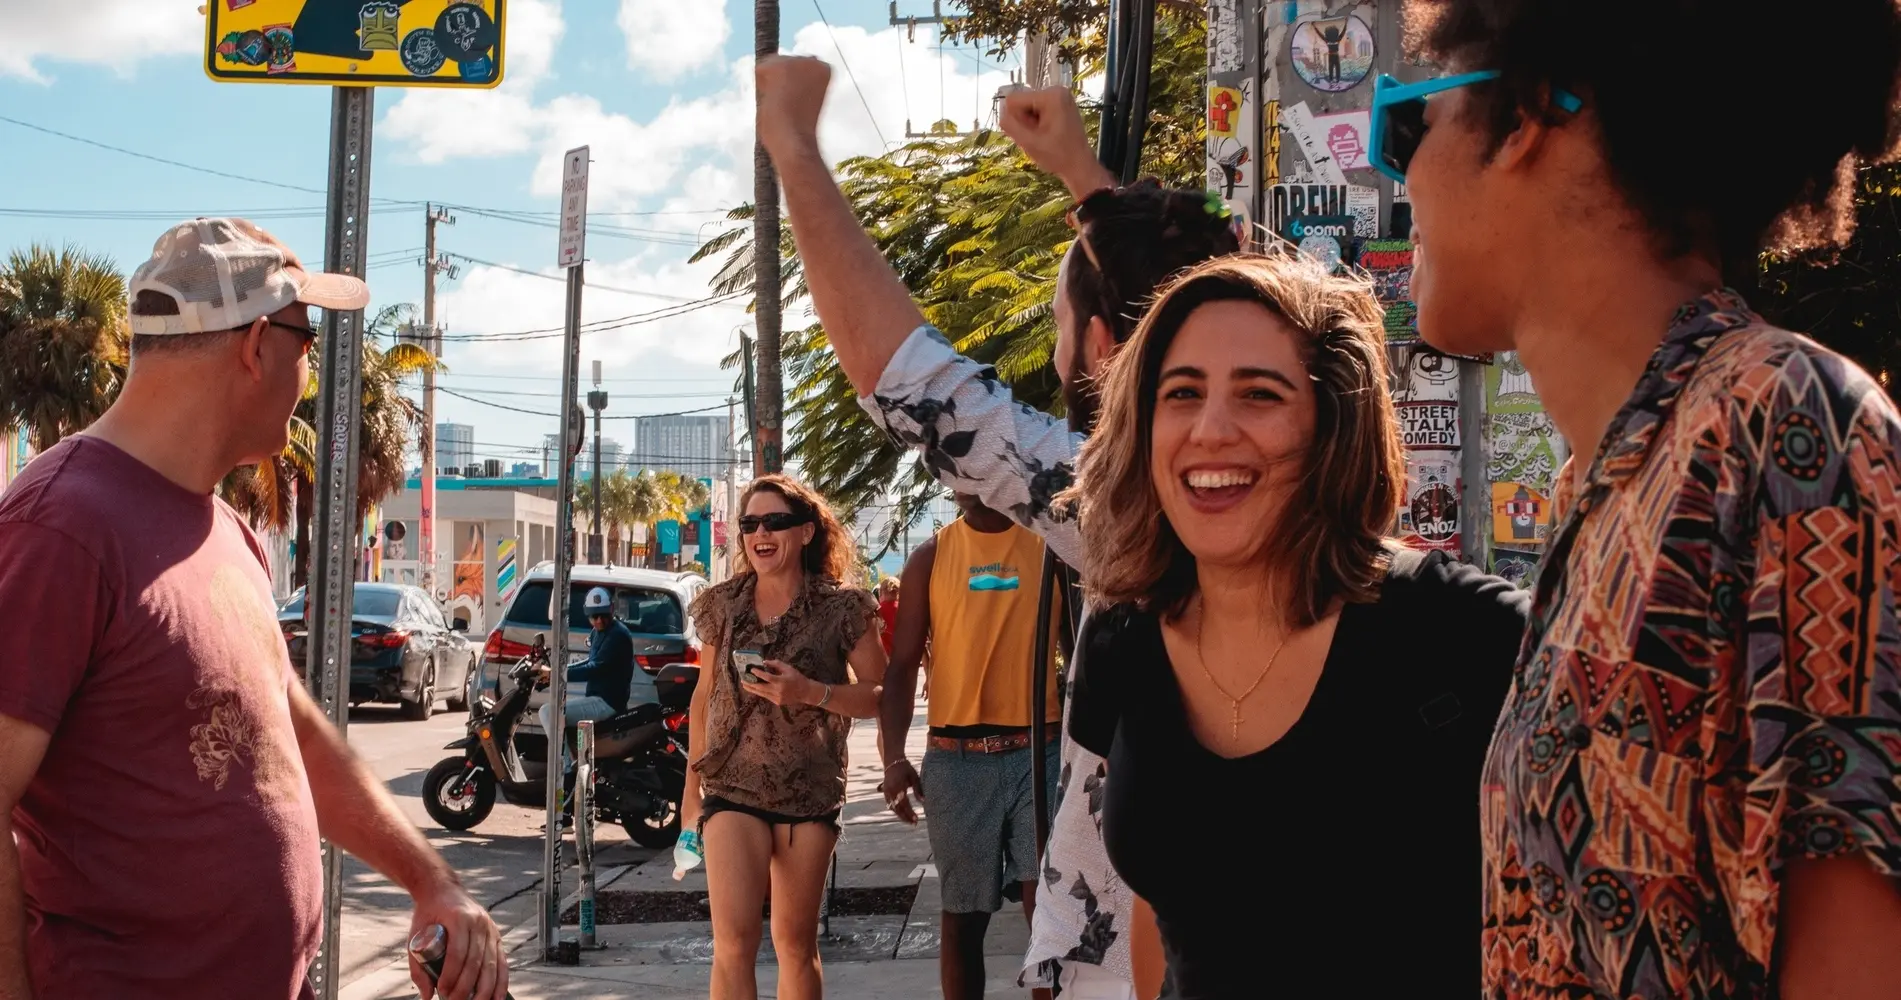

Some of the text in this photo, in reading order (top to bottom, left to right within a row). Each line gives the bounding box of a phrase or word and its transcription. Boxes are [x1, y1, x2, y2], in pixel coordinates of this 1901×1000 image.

[565, 175, 585, 194] PARKING
[568, 195, 579, 213] ANY
[566, 214, 579, 232] TIME
[1291, 220, 1346, 237] boomn
[1401, 406, 1456, 420] STREET
[1407, 418, 1456, 431] TALK
[1402, 431, 1456, 445] OMEDY
[1418, 520, 1455, 535] ENOZ
[969, 562, 1000, 574] swell
